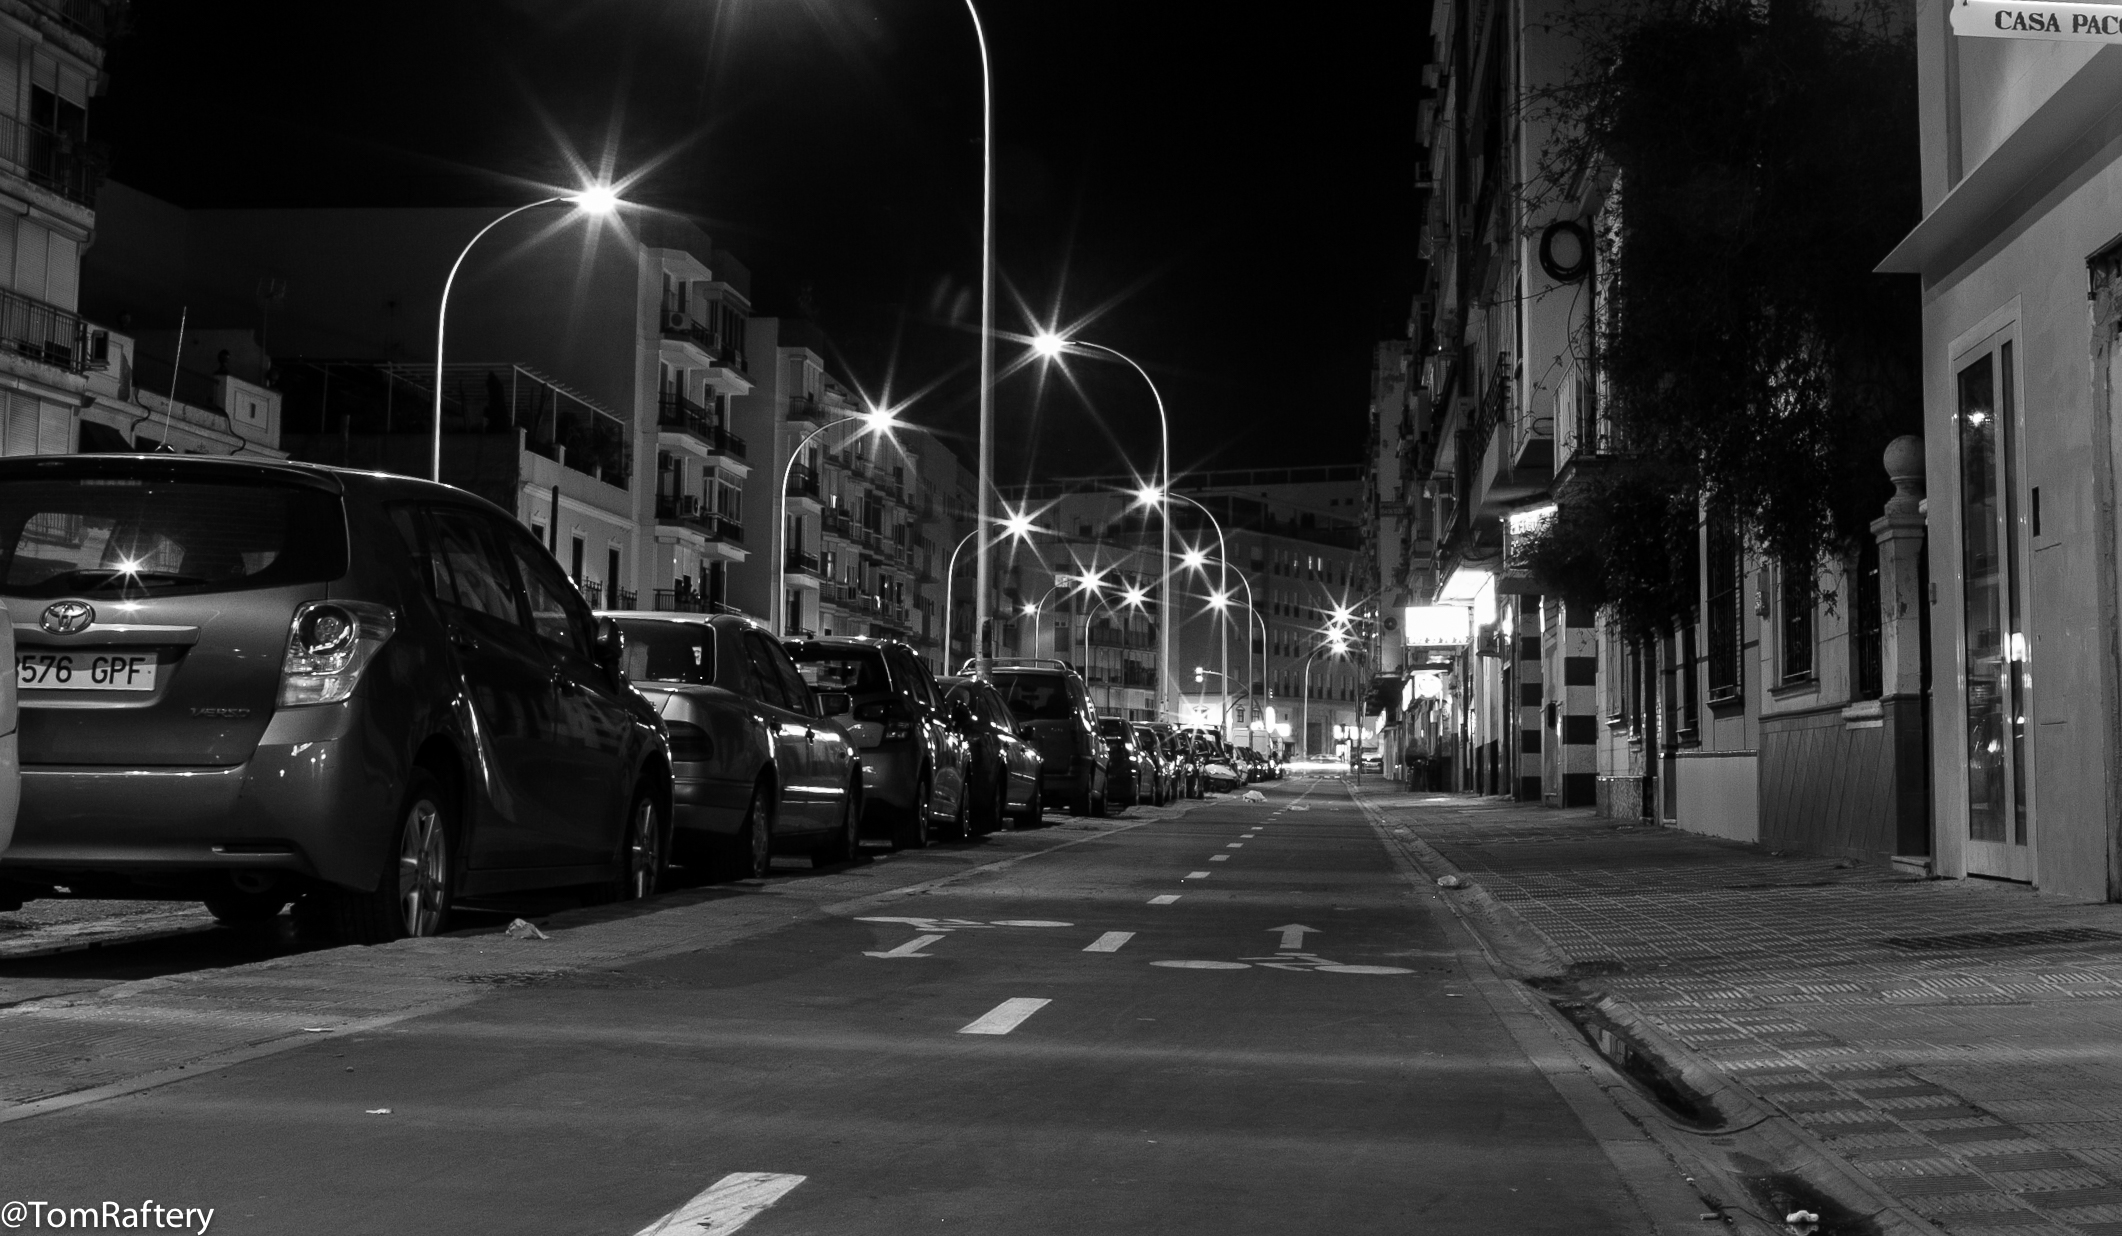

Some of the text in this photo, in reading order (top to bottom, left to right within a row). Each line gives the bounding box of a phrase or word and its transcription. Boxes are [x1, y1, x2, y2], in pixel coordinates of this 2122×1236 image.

[1994, 10, 2122, 35] CASA PAC
[16, 655, 146, 685] 576 GPF
[190, 707, 250, 718] VERSO
